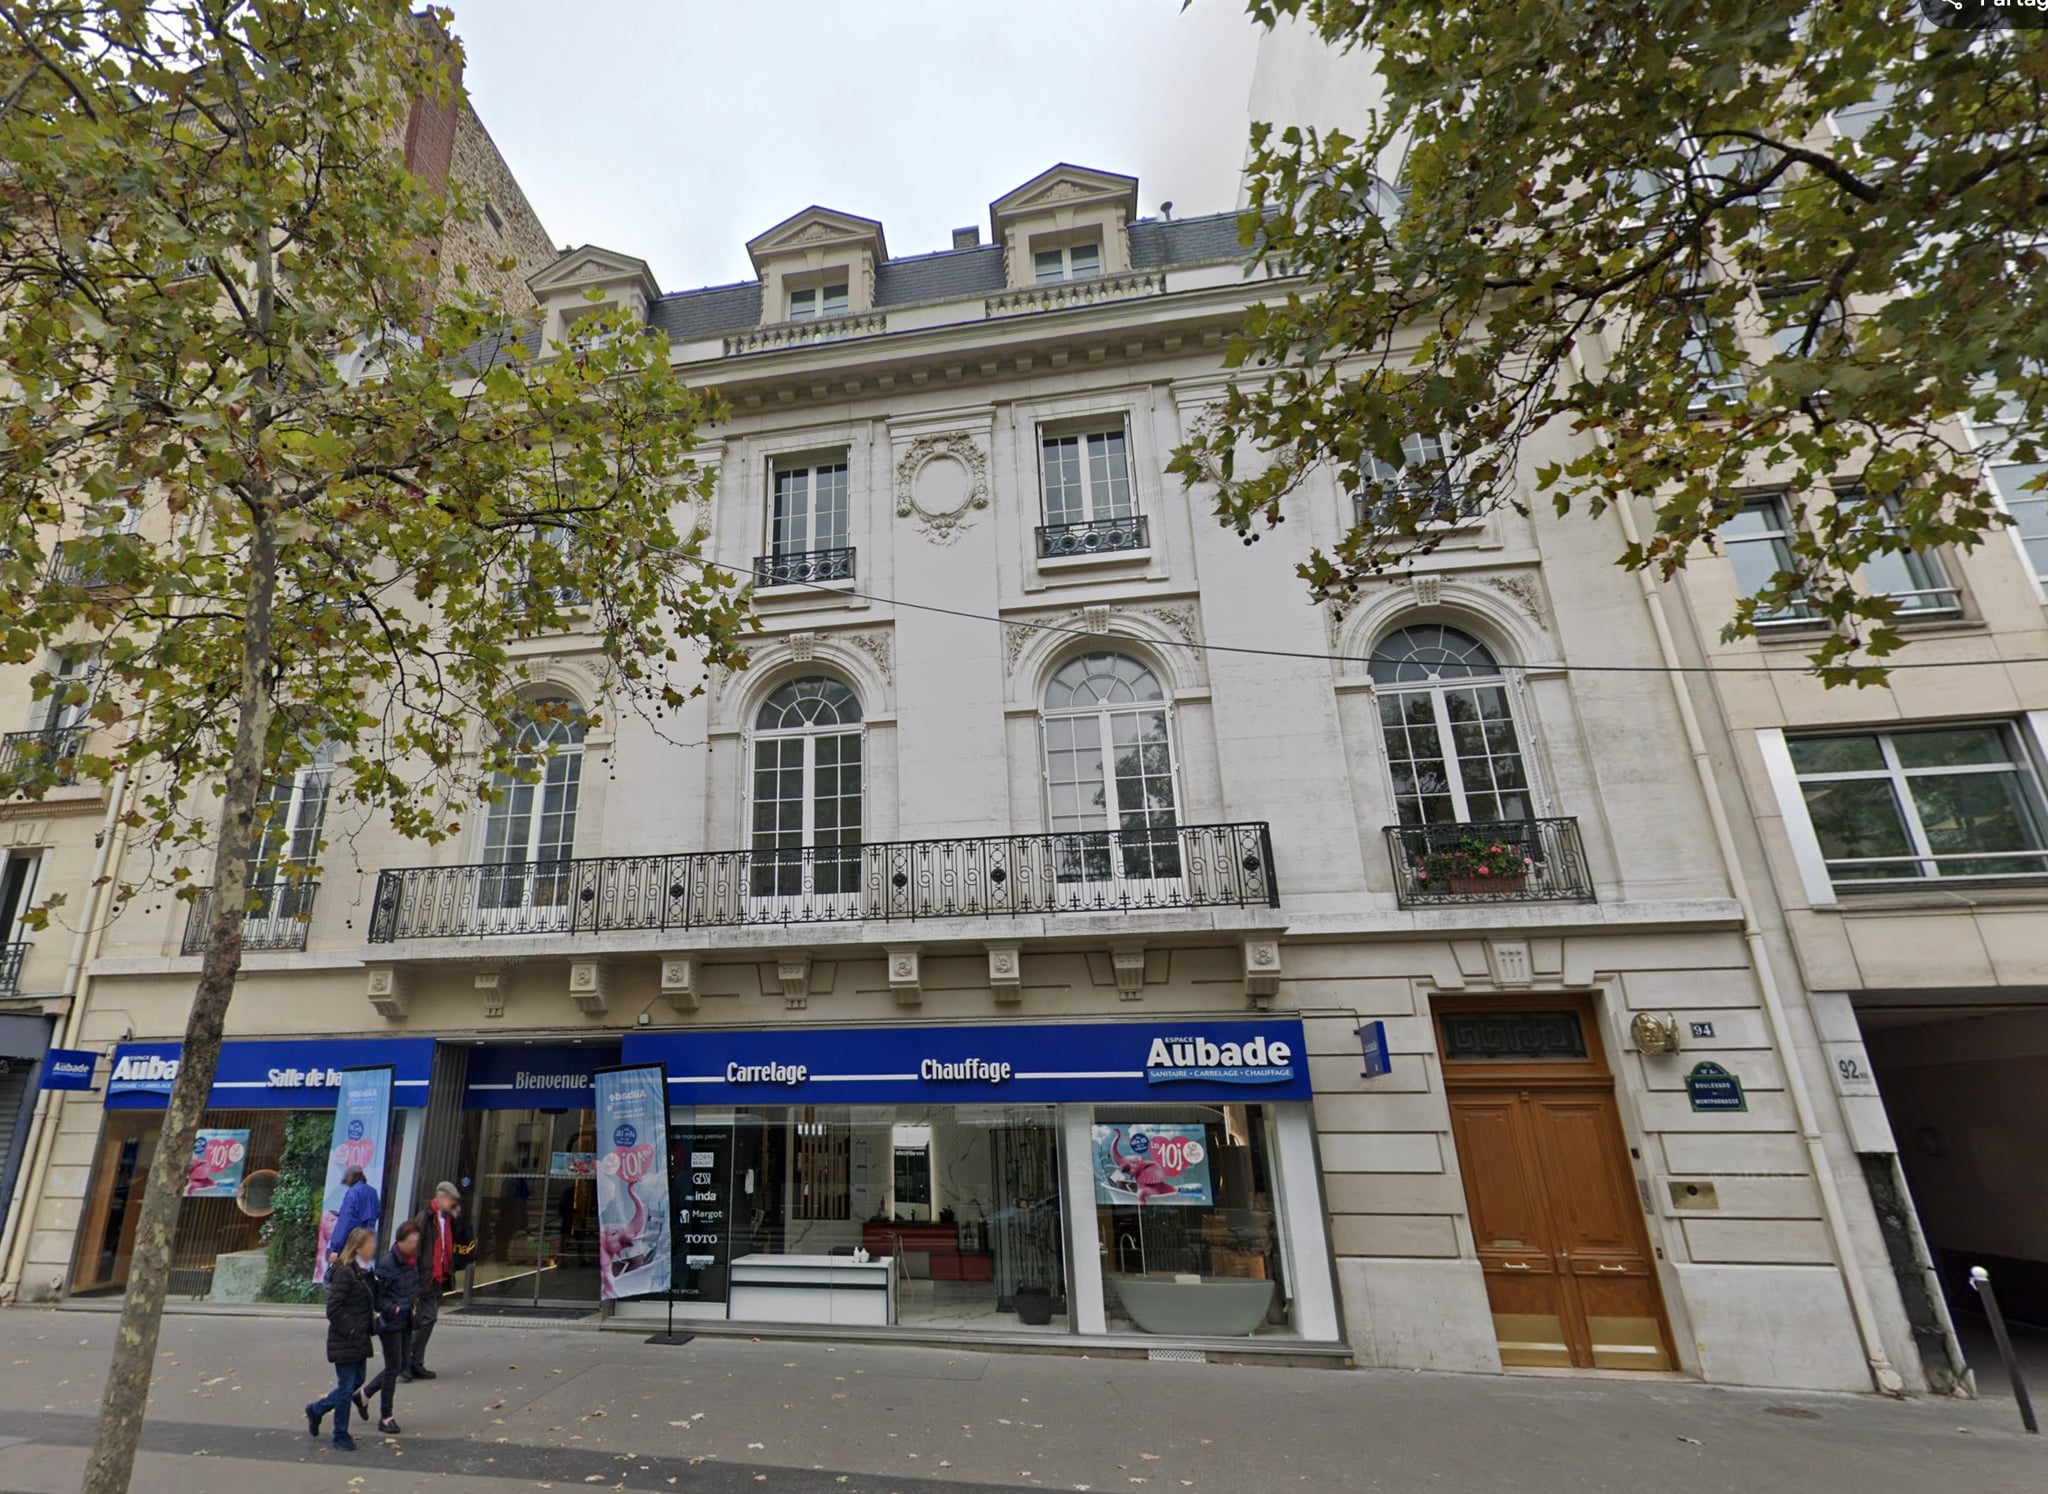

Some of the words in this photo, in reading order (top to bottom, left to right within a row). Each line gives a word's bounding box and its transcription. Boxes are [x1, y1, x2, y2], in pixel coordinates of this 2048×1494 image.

[1693, 1024, 1711, 1036] 94
[1146, 1036, 1292, 1067] Aubade
[52, 1062, 89, 1073] Aubade
[727, 1061, 807, 1085] Carrelage
[921, 1058, 1011, 1083] Chauffage
[1839, 1059, 1859, 1079] 92
[267, 1068, 305, 1087] Salle
[305, 1068, 325, 1087] de
[515, 1072, 588, 1089] Bienvenue
[695, 1191, 717, 1201] inda
[692, 1209, 723, 1220] Margot
[685, 1233, 718, 1244] TOTO
